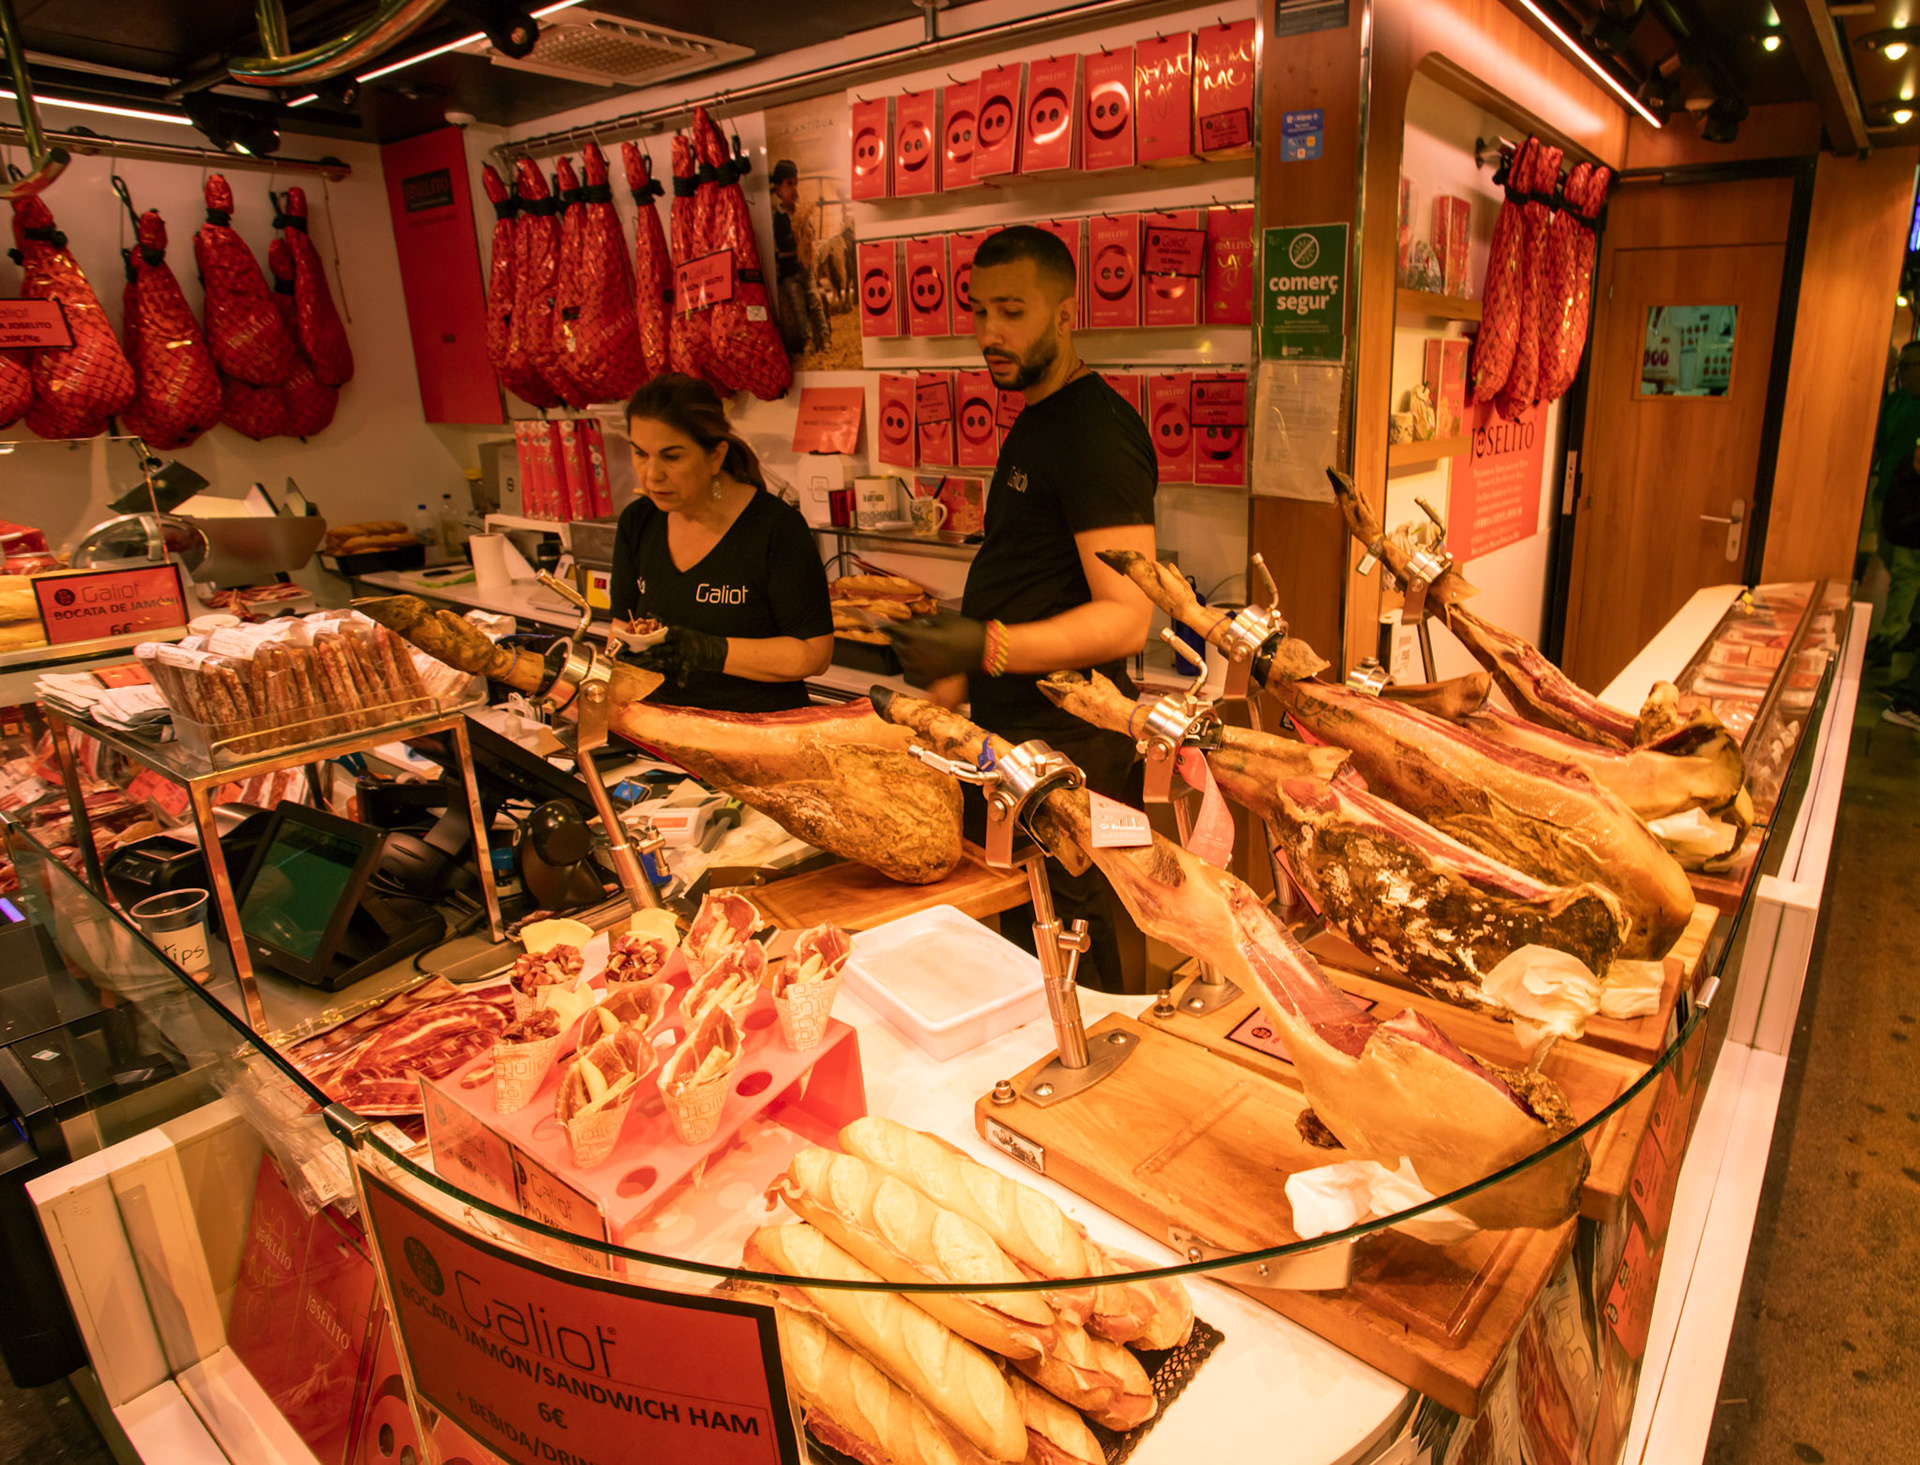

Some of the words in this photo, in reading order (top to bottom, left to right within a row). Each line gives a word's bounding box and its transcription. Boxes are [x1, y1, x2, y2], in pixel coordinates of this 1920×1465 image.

[1269, 275, 1339, 295] comerç
[1276, 295, 1330, 315] segur
[8, 321, 52, 330] JOSELITO
[1469, 420, 1535, 467] JOSELITO
[81, 580, 141, 604] Galiot
[695, 583, 749, 605] Galiot
[54, 606, 107, 621] BOCATA
[111, 602, 128, 613] DE
[110, 622, 133, 636] 6€
[162, 943, 205, 966] tips
[530, 1173, 573, 1221] Galiot
[305, 1294, 350, 1350] JOSELITO
[455, 1269, 617, 1378] Galiot
[400, 1279, 461, 1337] BOCATA
[464, 1325, 681, 1423] JAMÓN/SANDWICH
[688, 1406, 760, 1437] HAM
[537, 1401, 568, 1430] 6€
